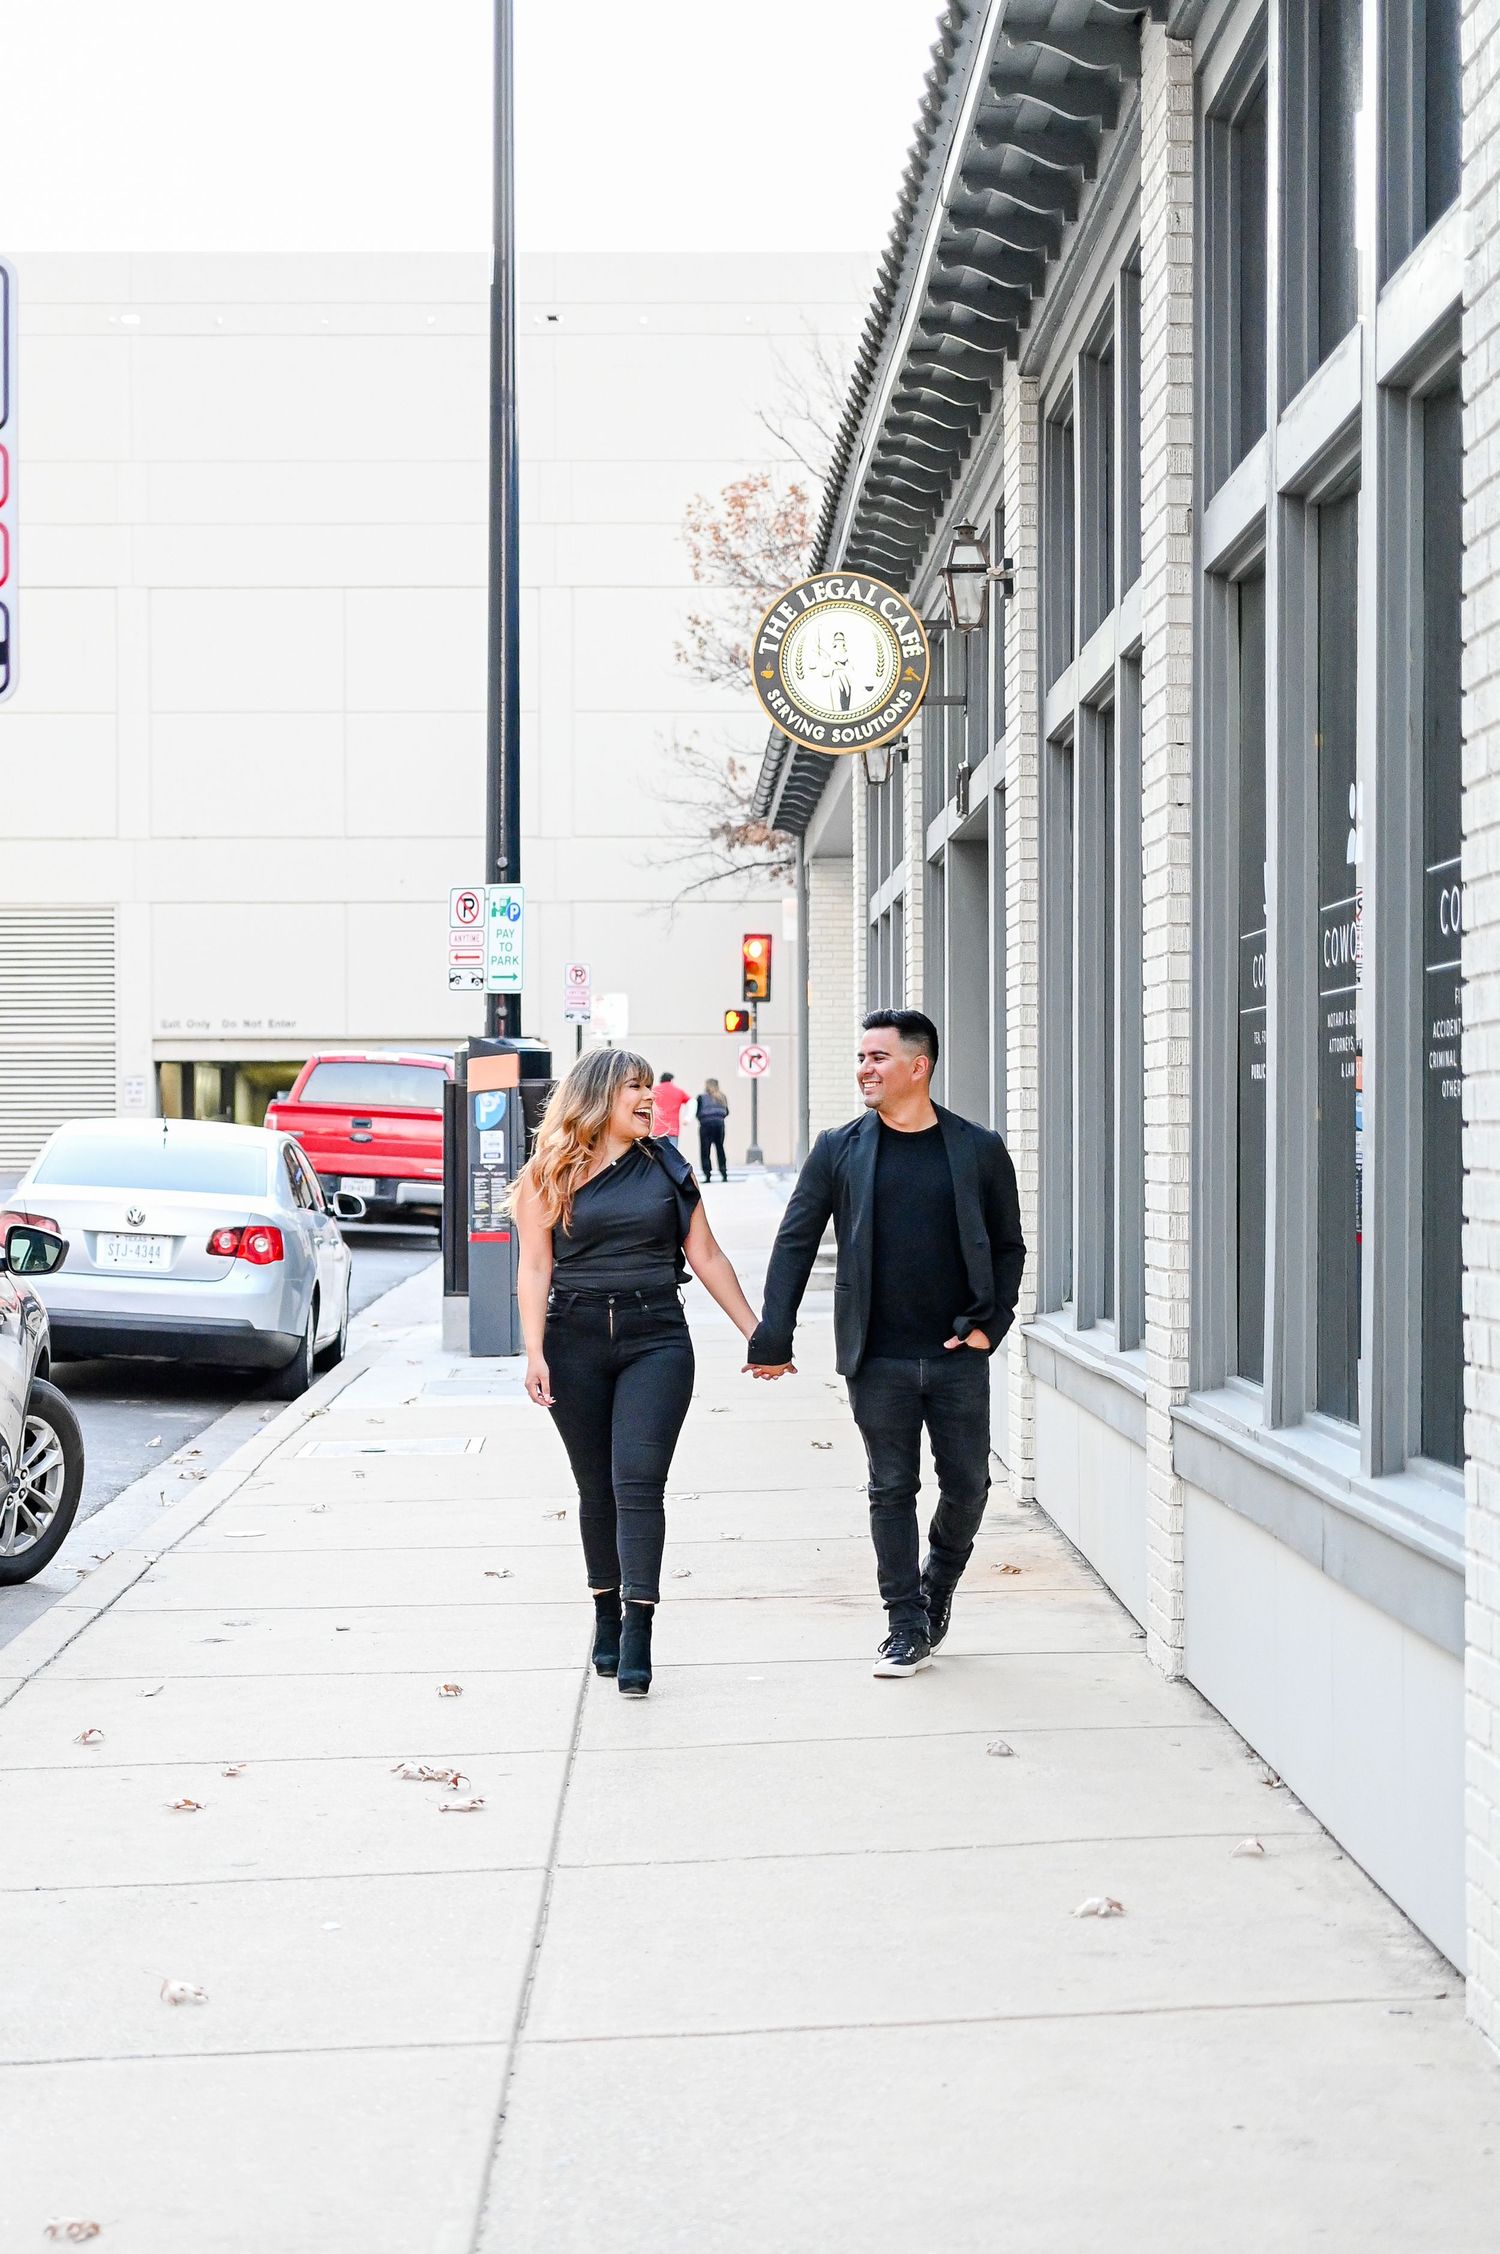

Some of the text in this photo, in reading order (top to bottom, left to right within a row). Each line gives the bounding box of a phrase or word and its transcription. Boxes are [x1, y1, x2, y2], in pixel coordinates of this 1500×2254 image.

[758, 602, 798, 655] THE
[796, 578, 878, 609] LEGAL
[767, 688, 913, 743] SERVING SOLUTIONS
[454, 933, 480, 943] ANYTIME
[496, 929, 515, 939] PAY
[499, 942, 513, 952] TO
[491, 956, 520, 965] PARK
[186, 1019, 211, 1030] Only
[221, 1019, 237, 1029] Do
[243, 1019, 262, 1029] Not
[267, 1019, 297, 1029] Enter
[1429, 1050, 1457, 1069] CRIMINAL
[1441, 1079, 1461, 1097] OTHER
[107, 1243, 161, 1259] STJ-4344
